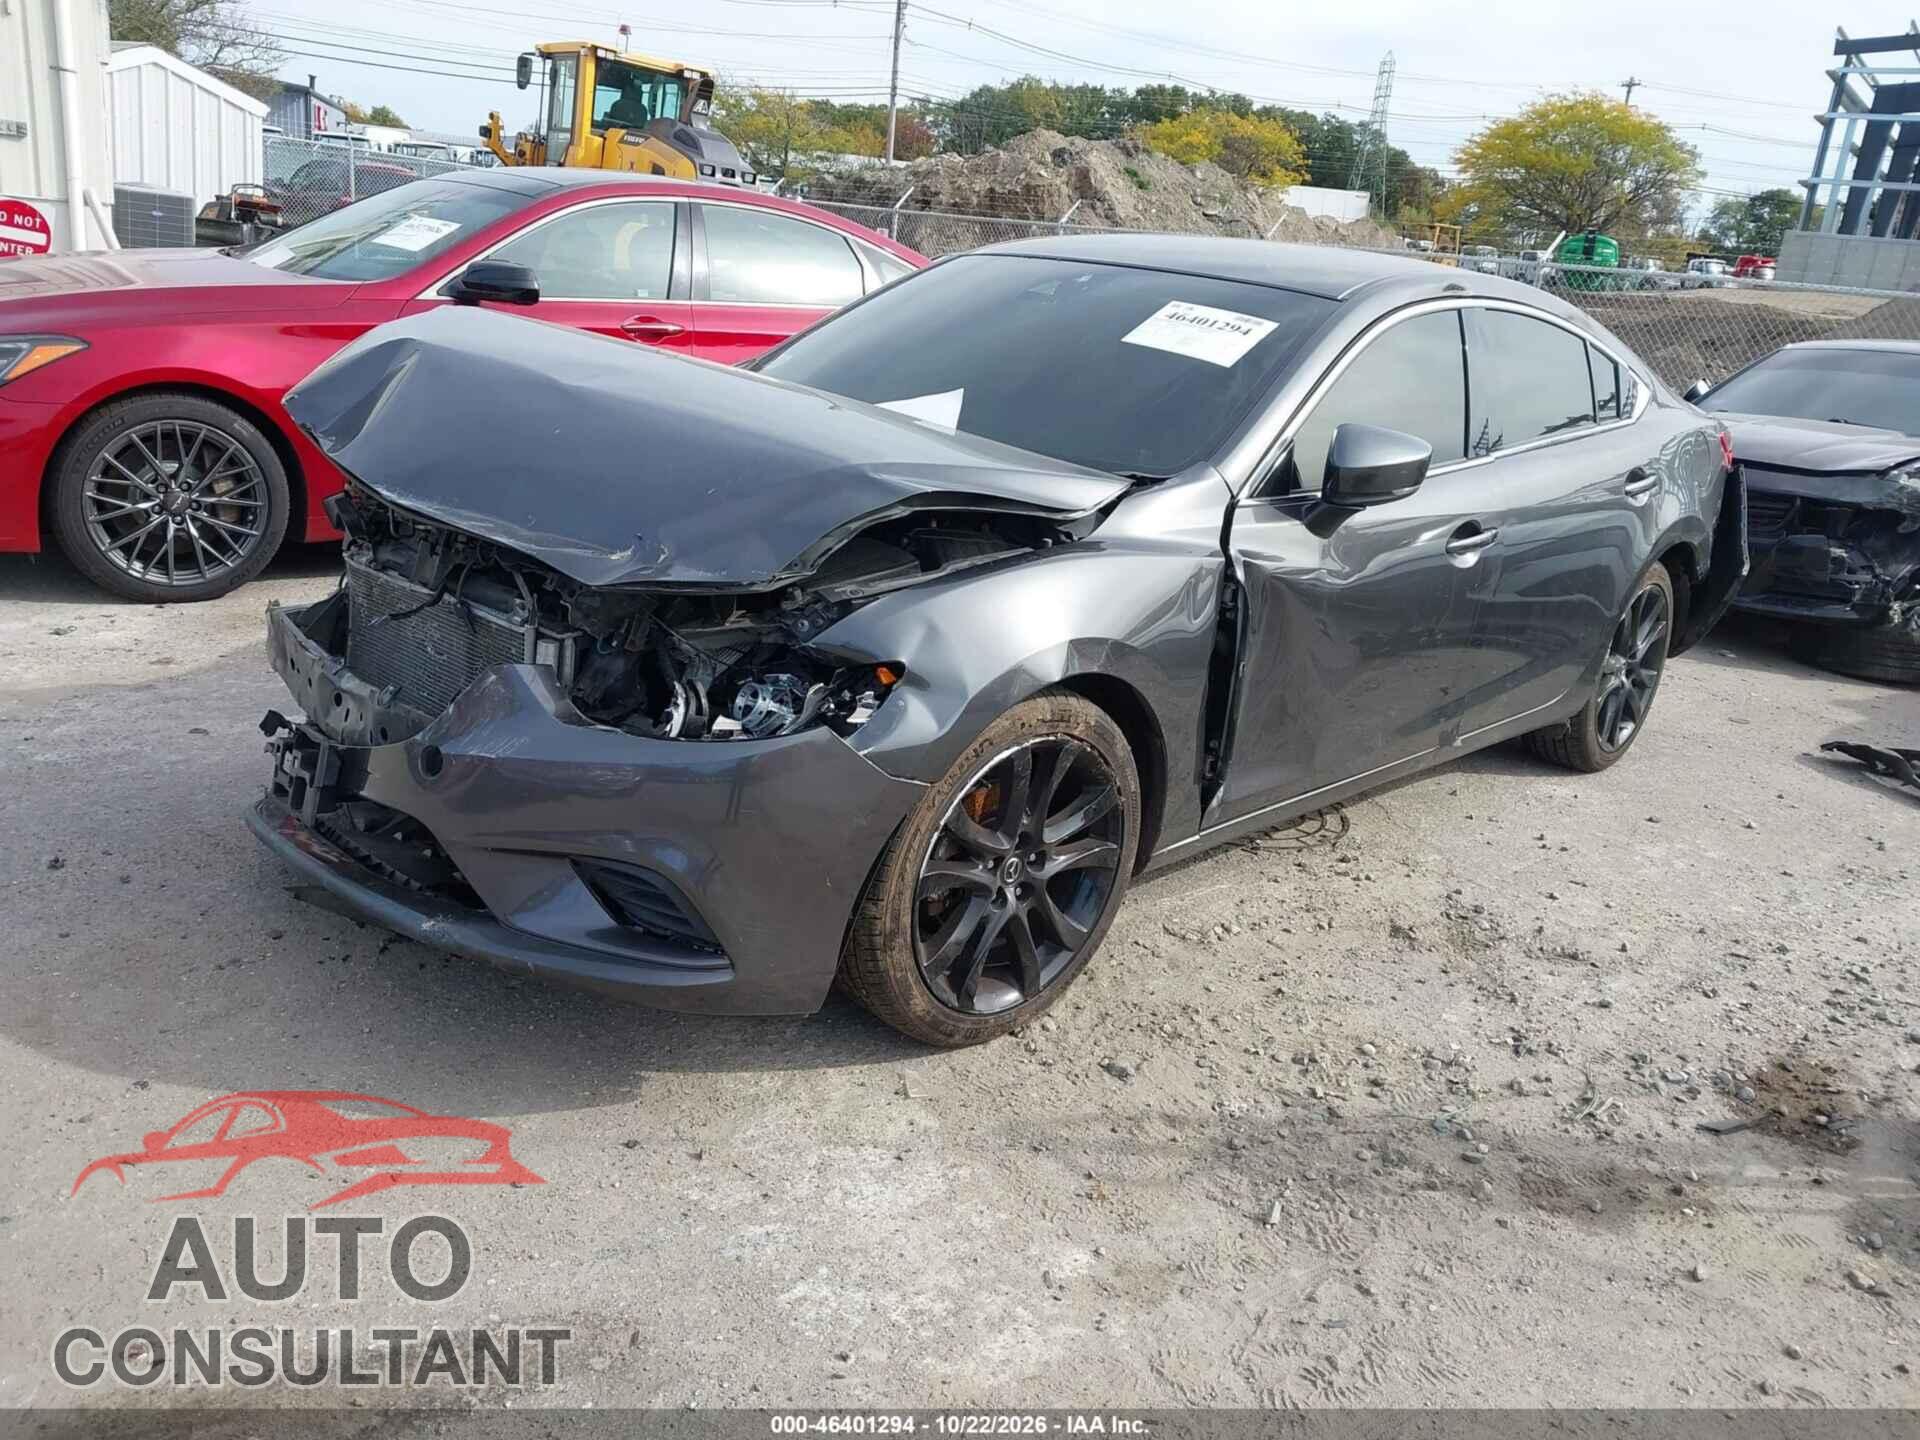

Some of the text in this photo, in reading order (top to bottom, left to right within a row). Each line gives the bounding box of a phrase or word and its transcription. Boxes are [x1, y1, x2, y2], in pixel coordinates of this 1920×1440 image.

[0, 210, 42, 229] O NOT
[0, 241, 34, 257] NTER
[1166, 311, 1253, 336] 46401294
